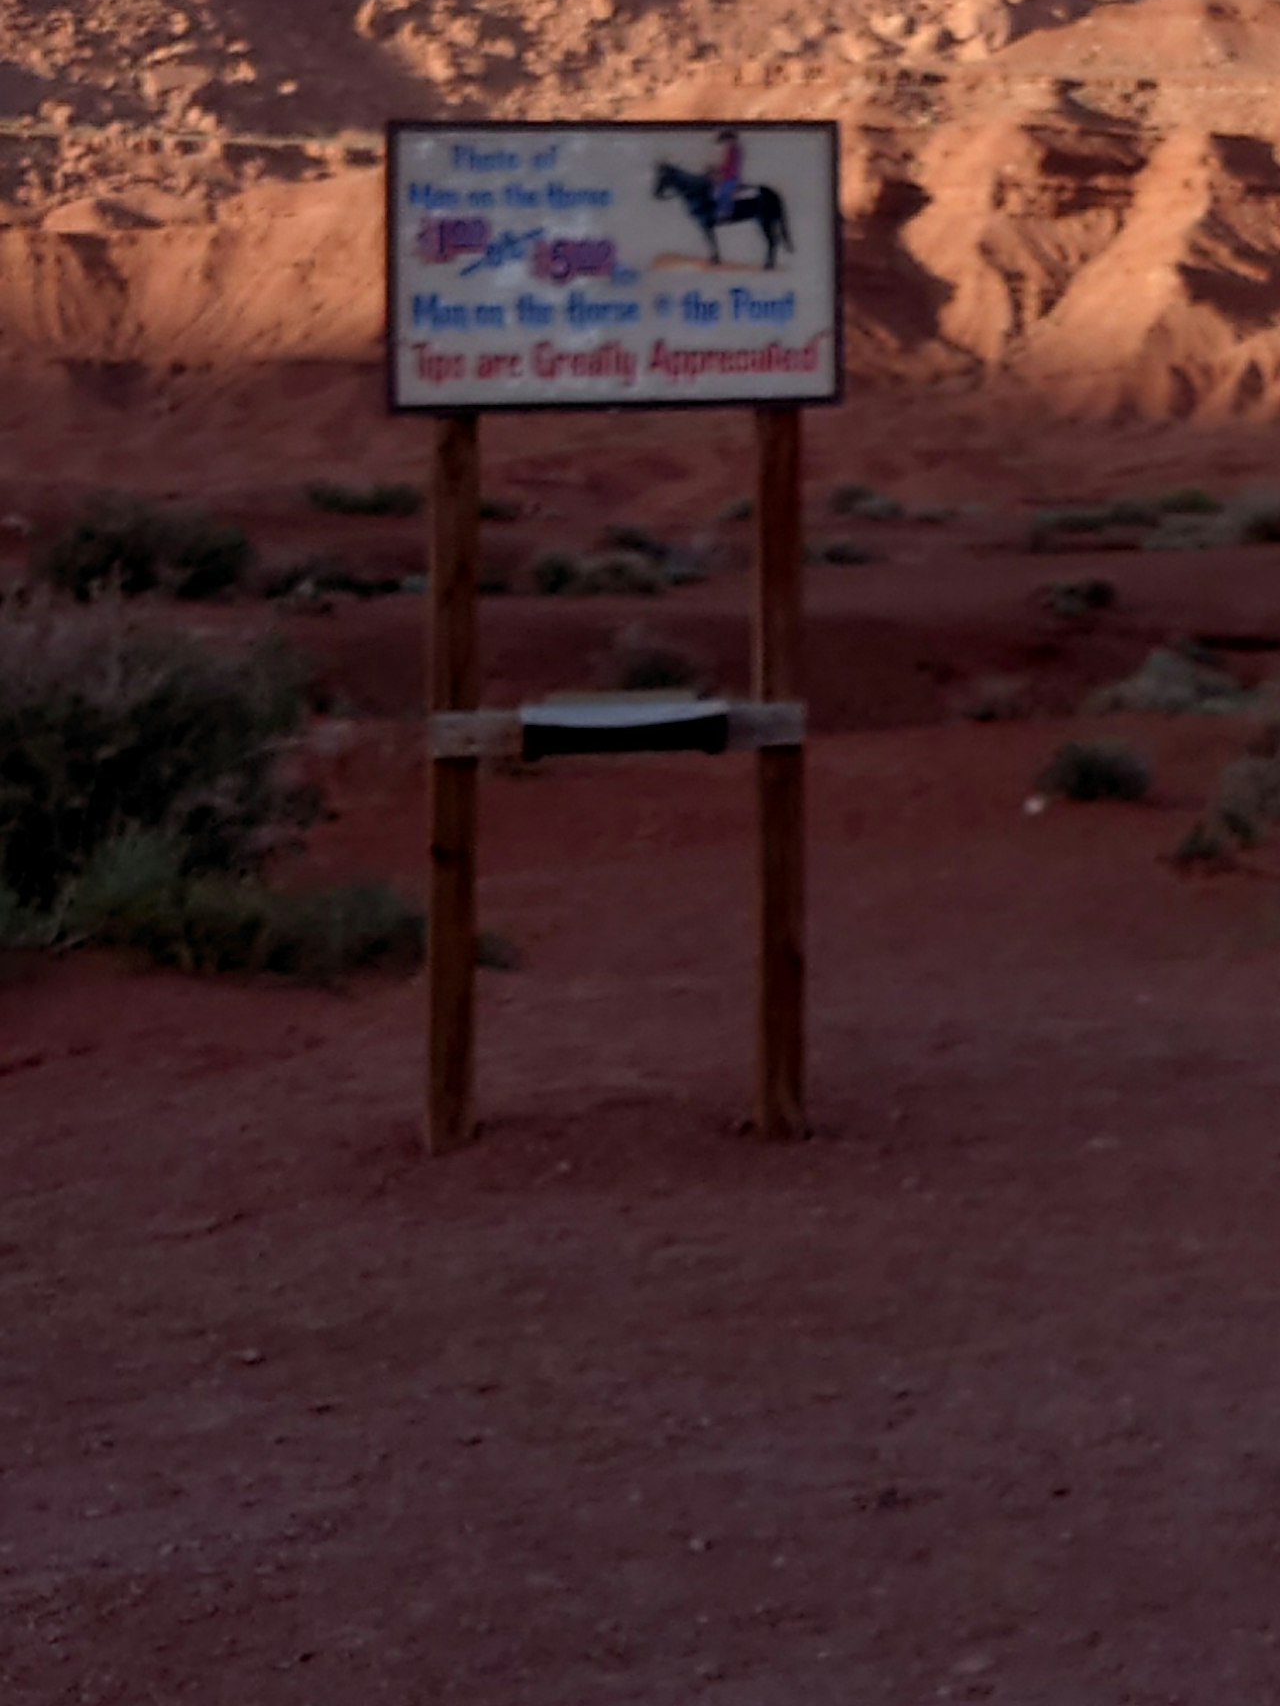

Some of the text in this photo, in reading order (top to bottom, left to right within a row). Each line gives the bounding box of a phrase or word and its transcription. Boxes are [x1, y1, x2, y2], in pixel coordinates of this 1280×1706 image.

[516, 291, 554, 327] the
[566, 289, 640, 330] Horse
[681, 288, 720, 326] the
[729, 286, 796, 328] Point
[412, 340, 467, 387] Tips
[475, 352, 524, 381] are
[533, 340, 638, 388] Greatly
